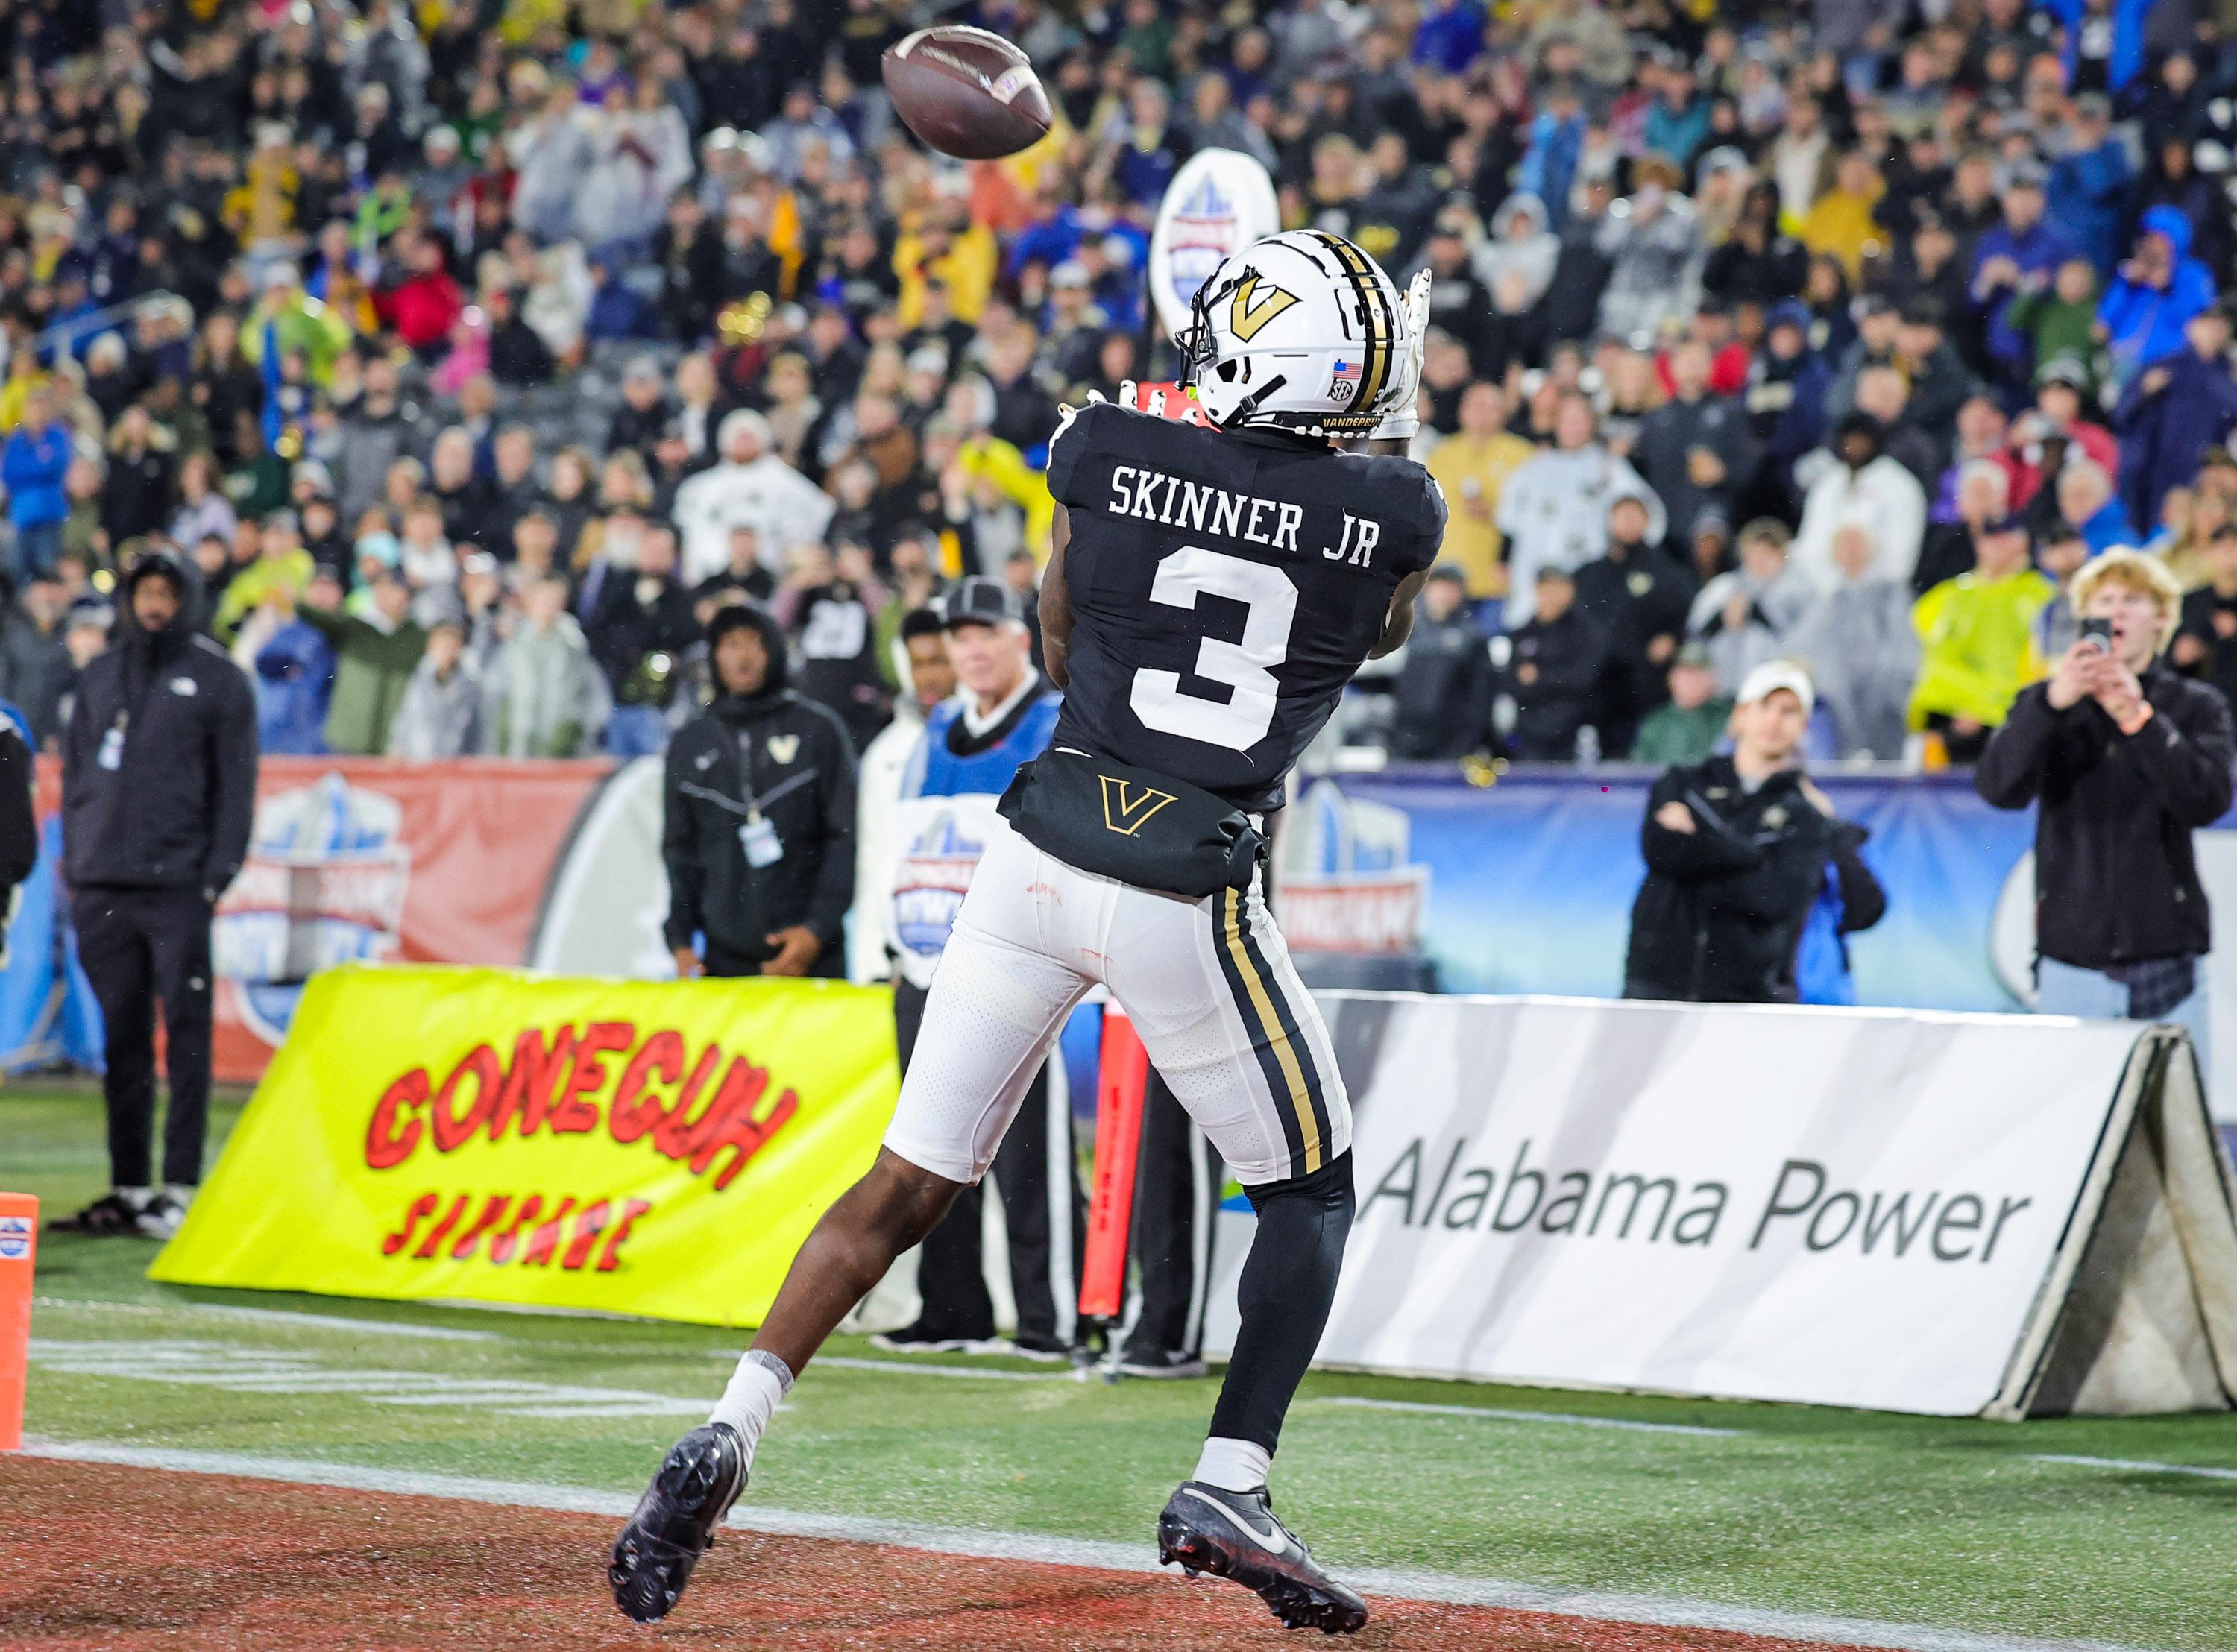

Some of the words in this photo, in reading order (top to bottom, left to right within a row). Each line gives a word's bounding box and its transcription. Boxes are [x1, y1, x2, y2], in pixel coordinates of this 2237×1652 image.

[1230, 271, 1303, 343] V
[1331, 382, 1351, 400] SEC
[1109, 465, 1303, 552] SKINNER
[1322, 514, 1380, 569] JR
[1129, 545, 1300, 752] 3
[1098, 774, 1179, 836] V
[365, 1020, 799, 1191] CONECUH
[1354, 1137, 1731, 1249] Alabama
[1746, 1158, 2032, 1264] Power
